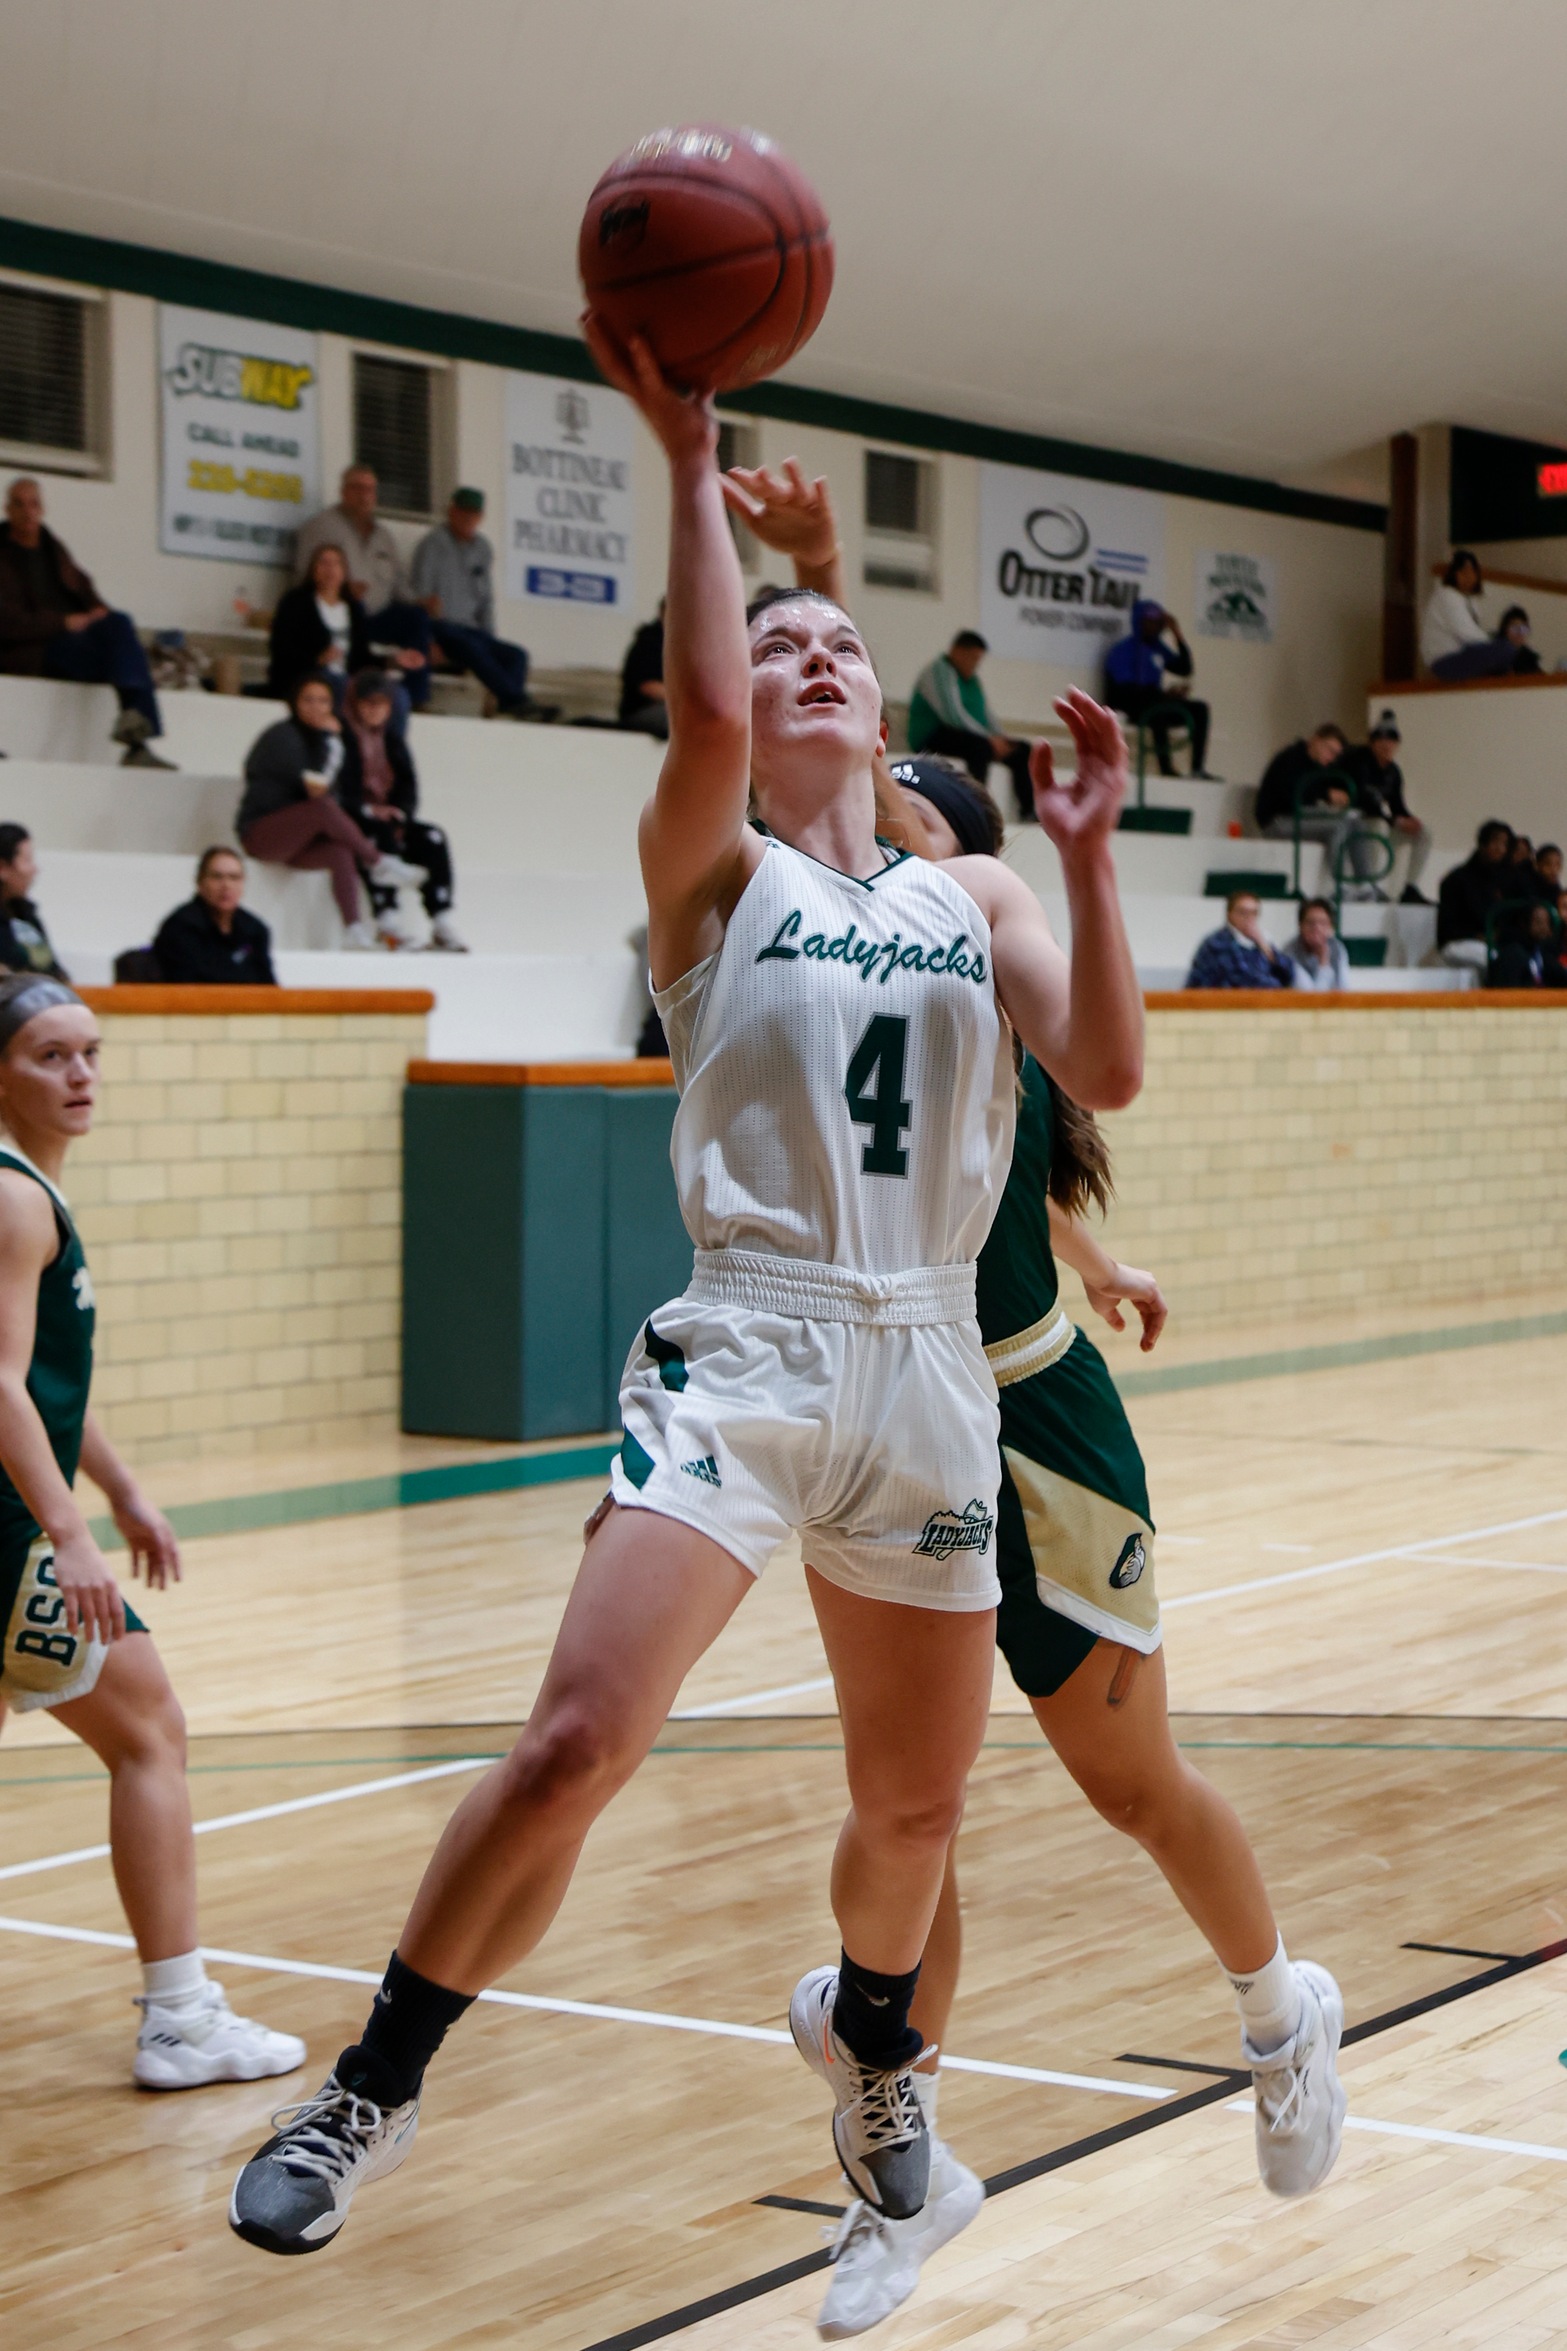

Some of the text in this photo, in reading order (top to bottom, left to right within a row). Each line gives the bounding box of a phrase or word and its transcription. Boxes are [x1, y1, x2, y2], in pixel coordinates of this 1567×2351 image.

[166, 341, 315, 411] SUBWAY
[187, 421, 234, 448] CALL
[536, 486, 606, 524] CLINIC
[514, 519, 628, 563] PHARMACY
[755, 907, 988, 985] Ladyjacks
[842, 1011, 914, 1181] 4
[912, 1515, 994, 1557] LADYJACKS
